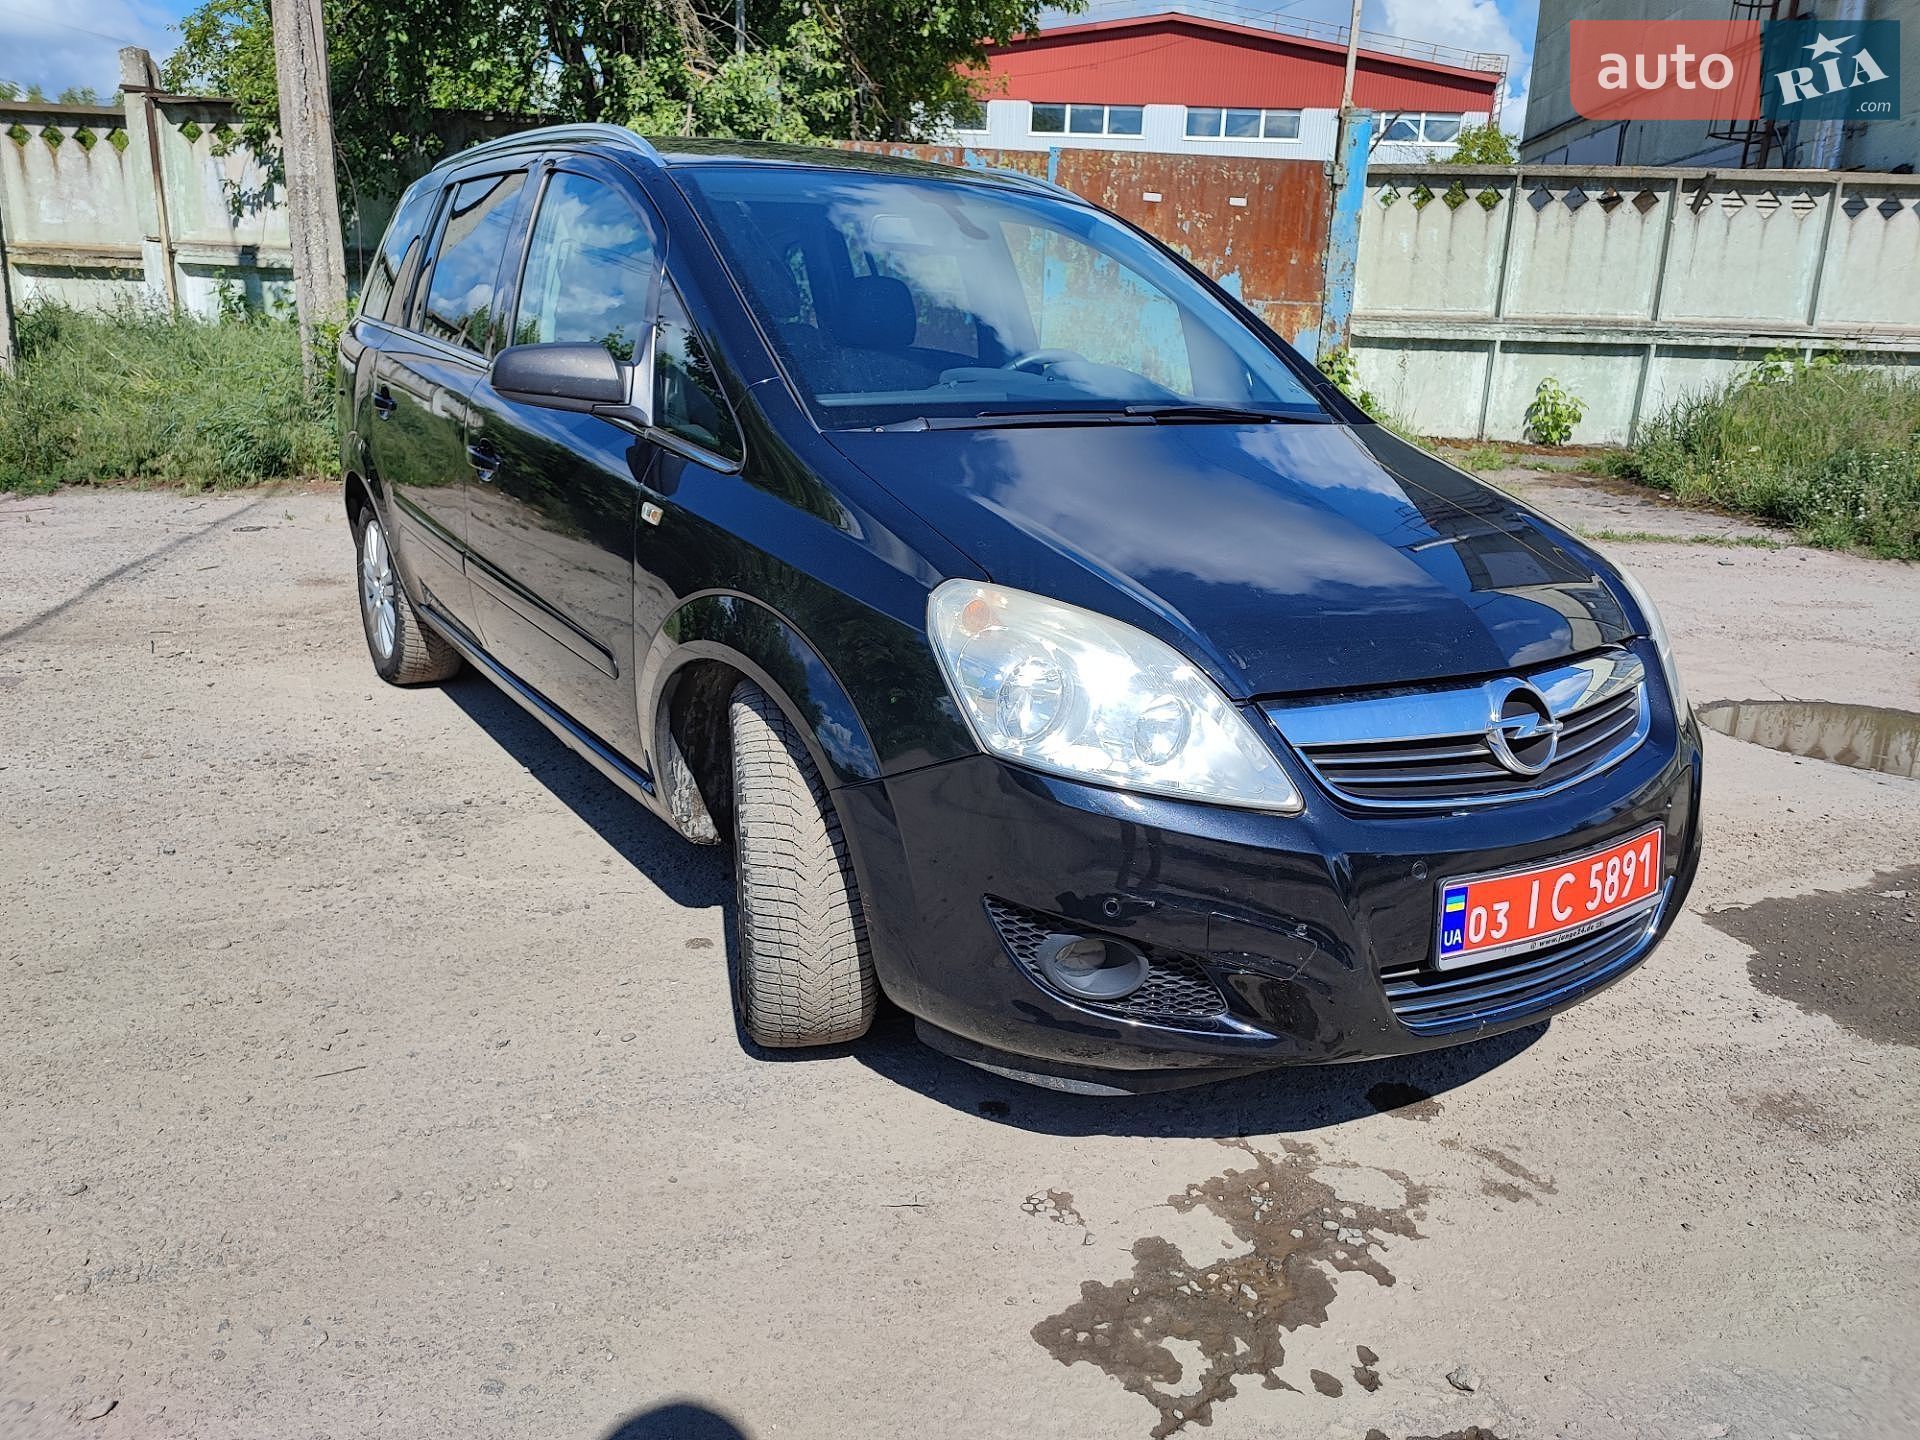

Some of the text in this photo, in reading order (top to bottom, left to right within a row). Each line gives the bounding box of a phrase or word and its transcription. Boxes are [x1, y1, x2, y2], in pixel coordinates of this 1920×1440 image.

[1468, 842, 1651, 944] 03 IC 5891
[1444, 930, 1462, 946] UA
